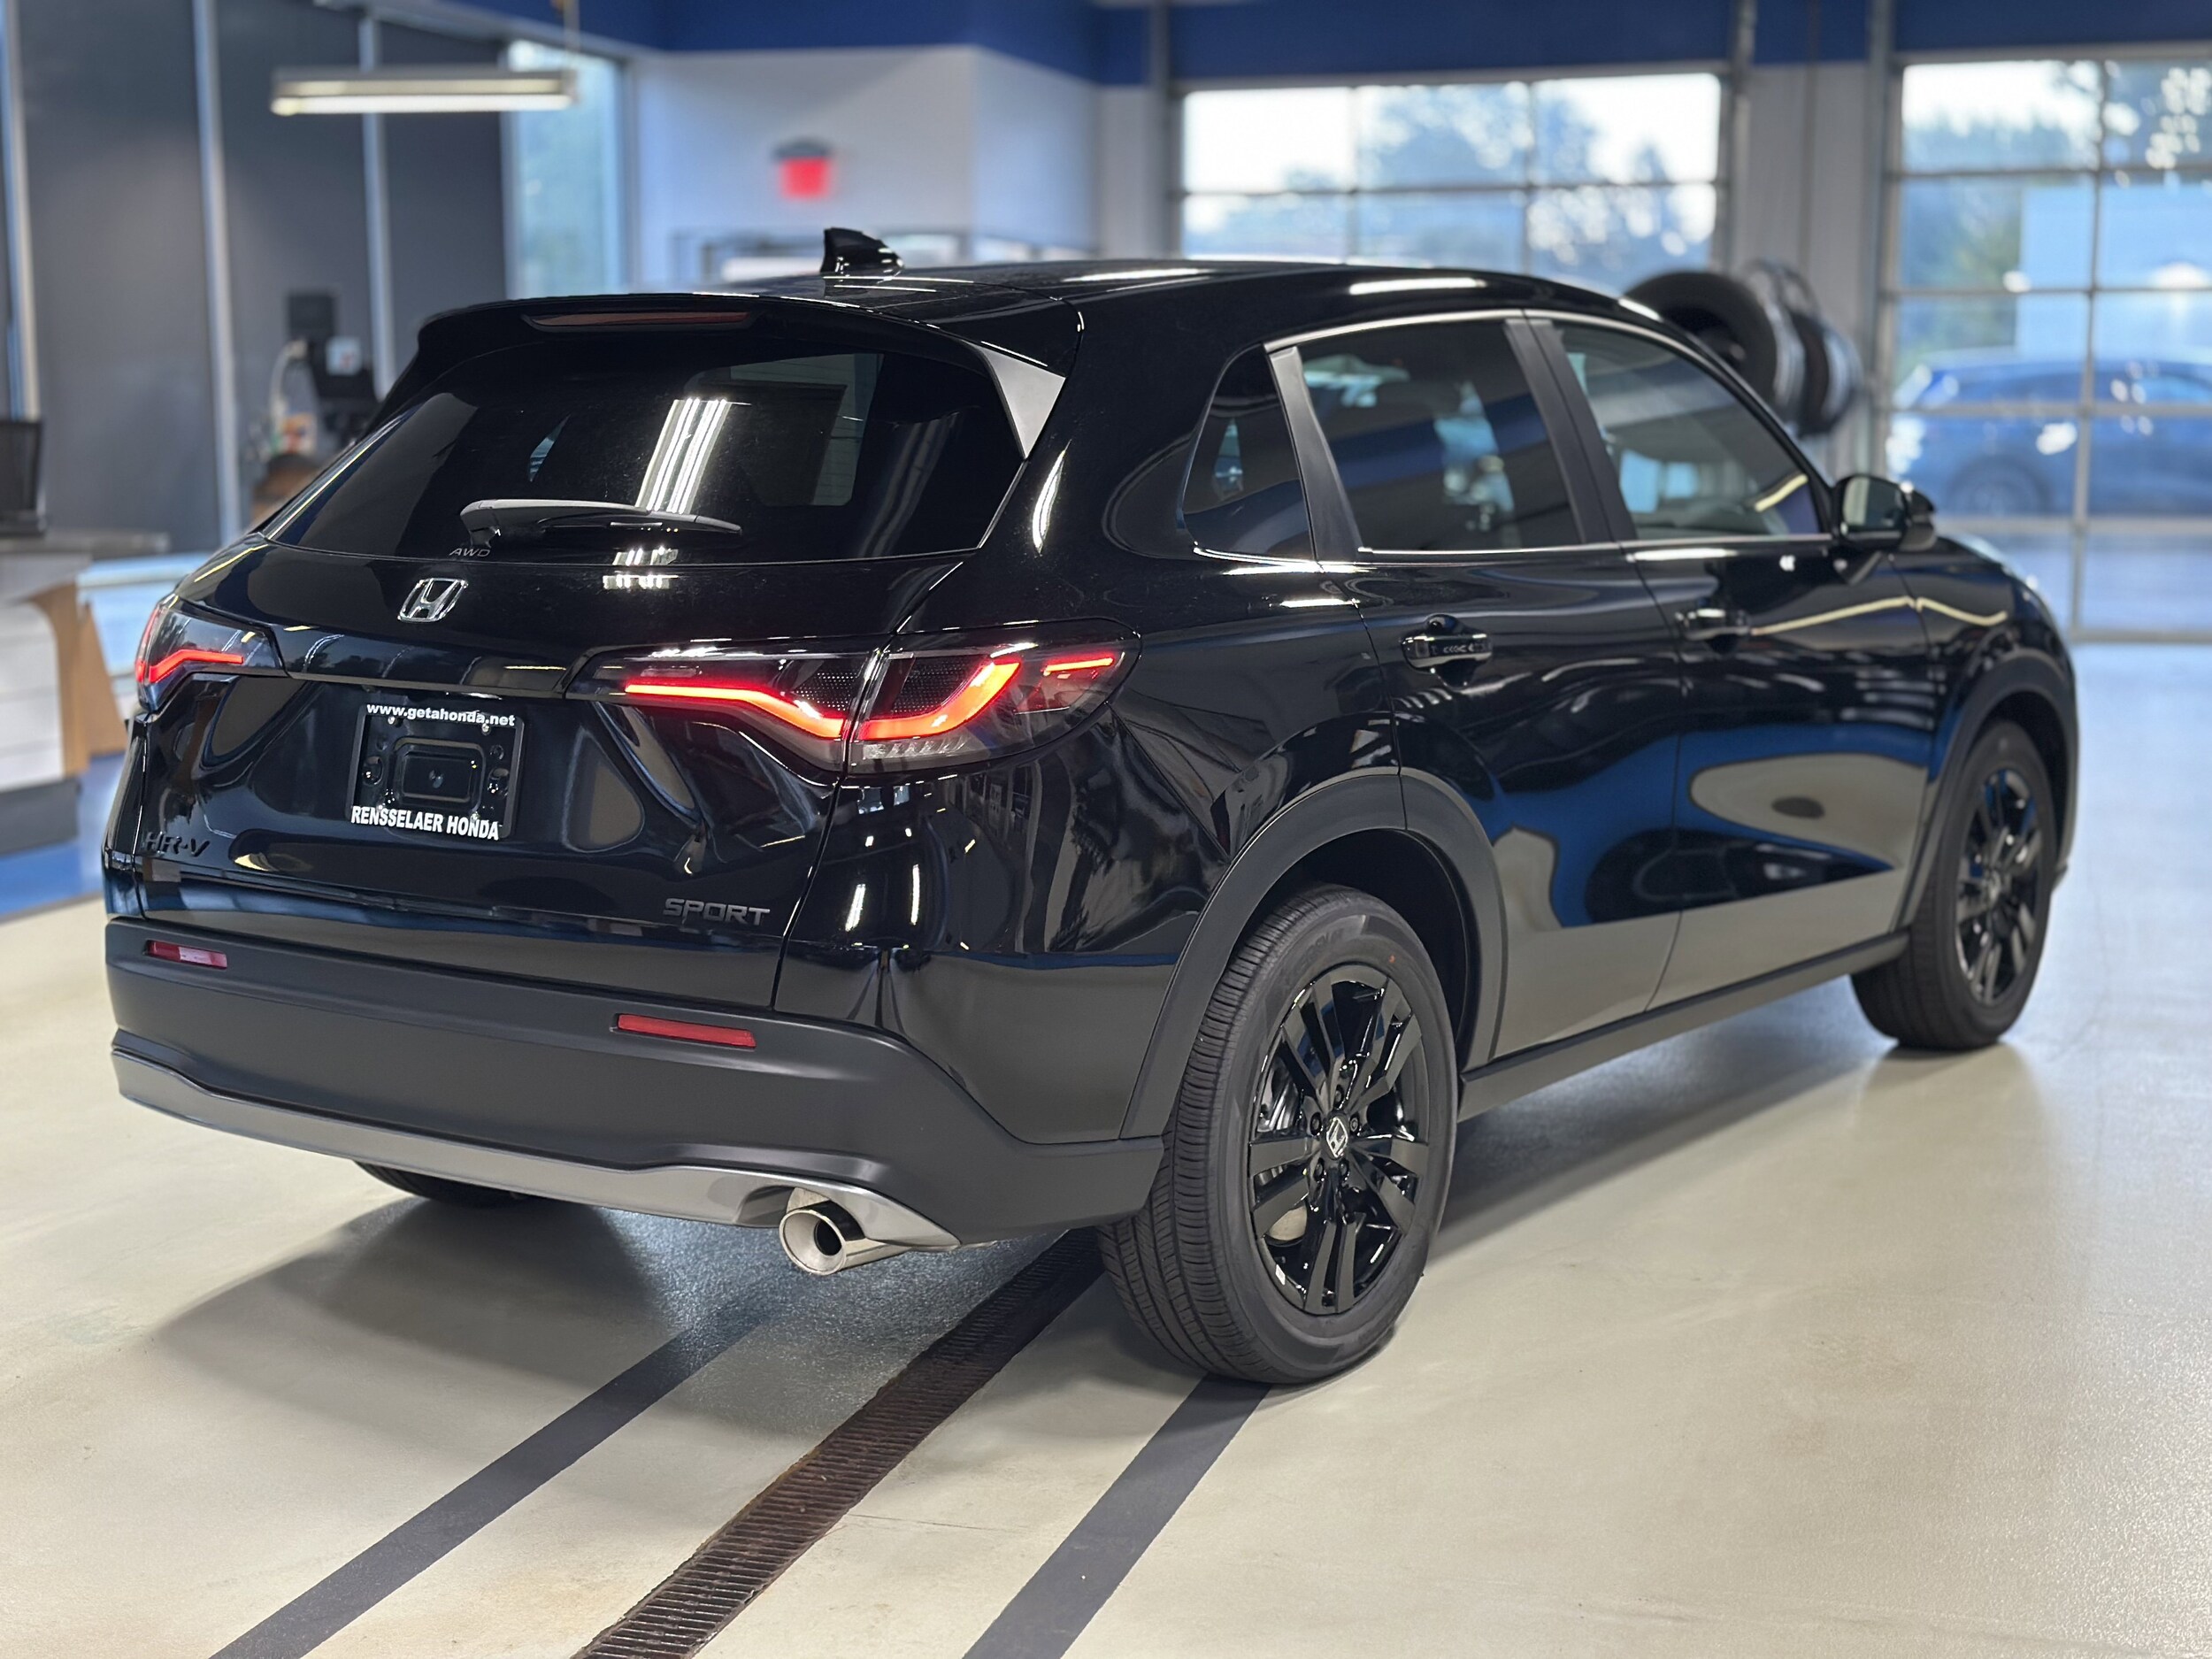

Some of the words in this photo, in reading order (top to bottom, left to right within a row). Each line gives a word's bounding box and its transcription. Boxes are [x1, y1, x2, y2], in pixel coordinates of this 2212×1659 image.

[449, 548, 491, 557] AWD
[366, 703, 516, 726] www.getahonda.net
[350, 804, 443, 833] RENSSELAER
[446, 815, 499, 841] HONDA
[146, 832, 210, 857] HR-V
[663, 897, 771, 926] SPORT
